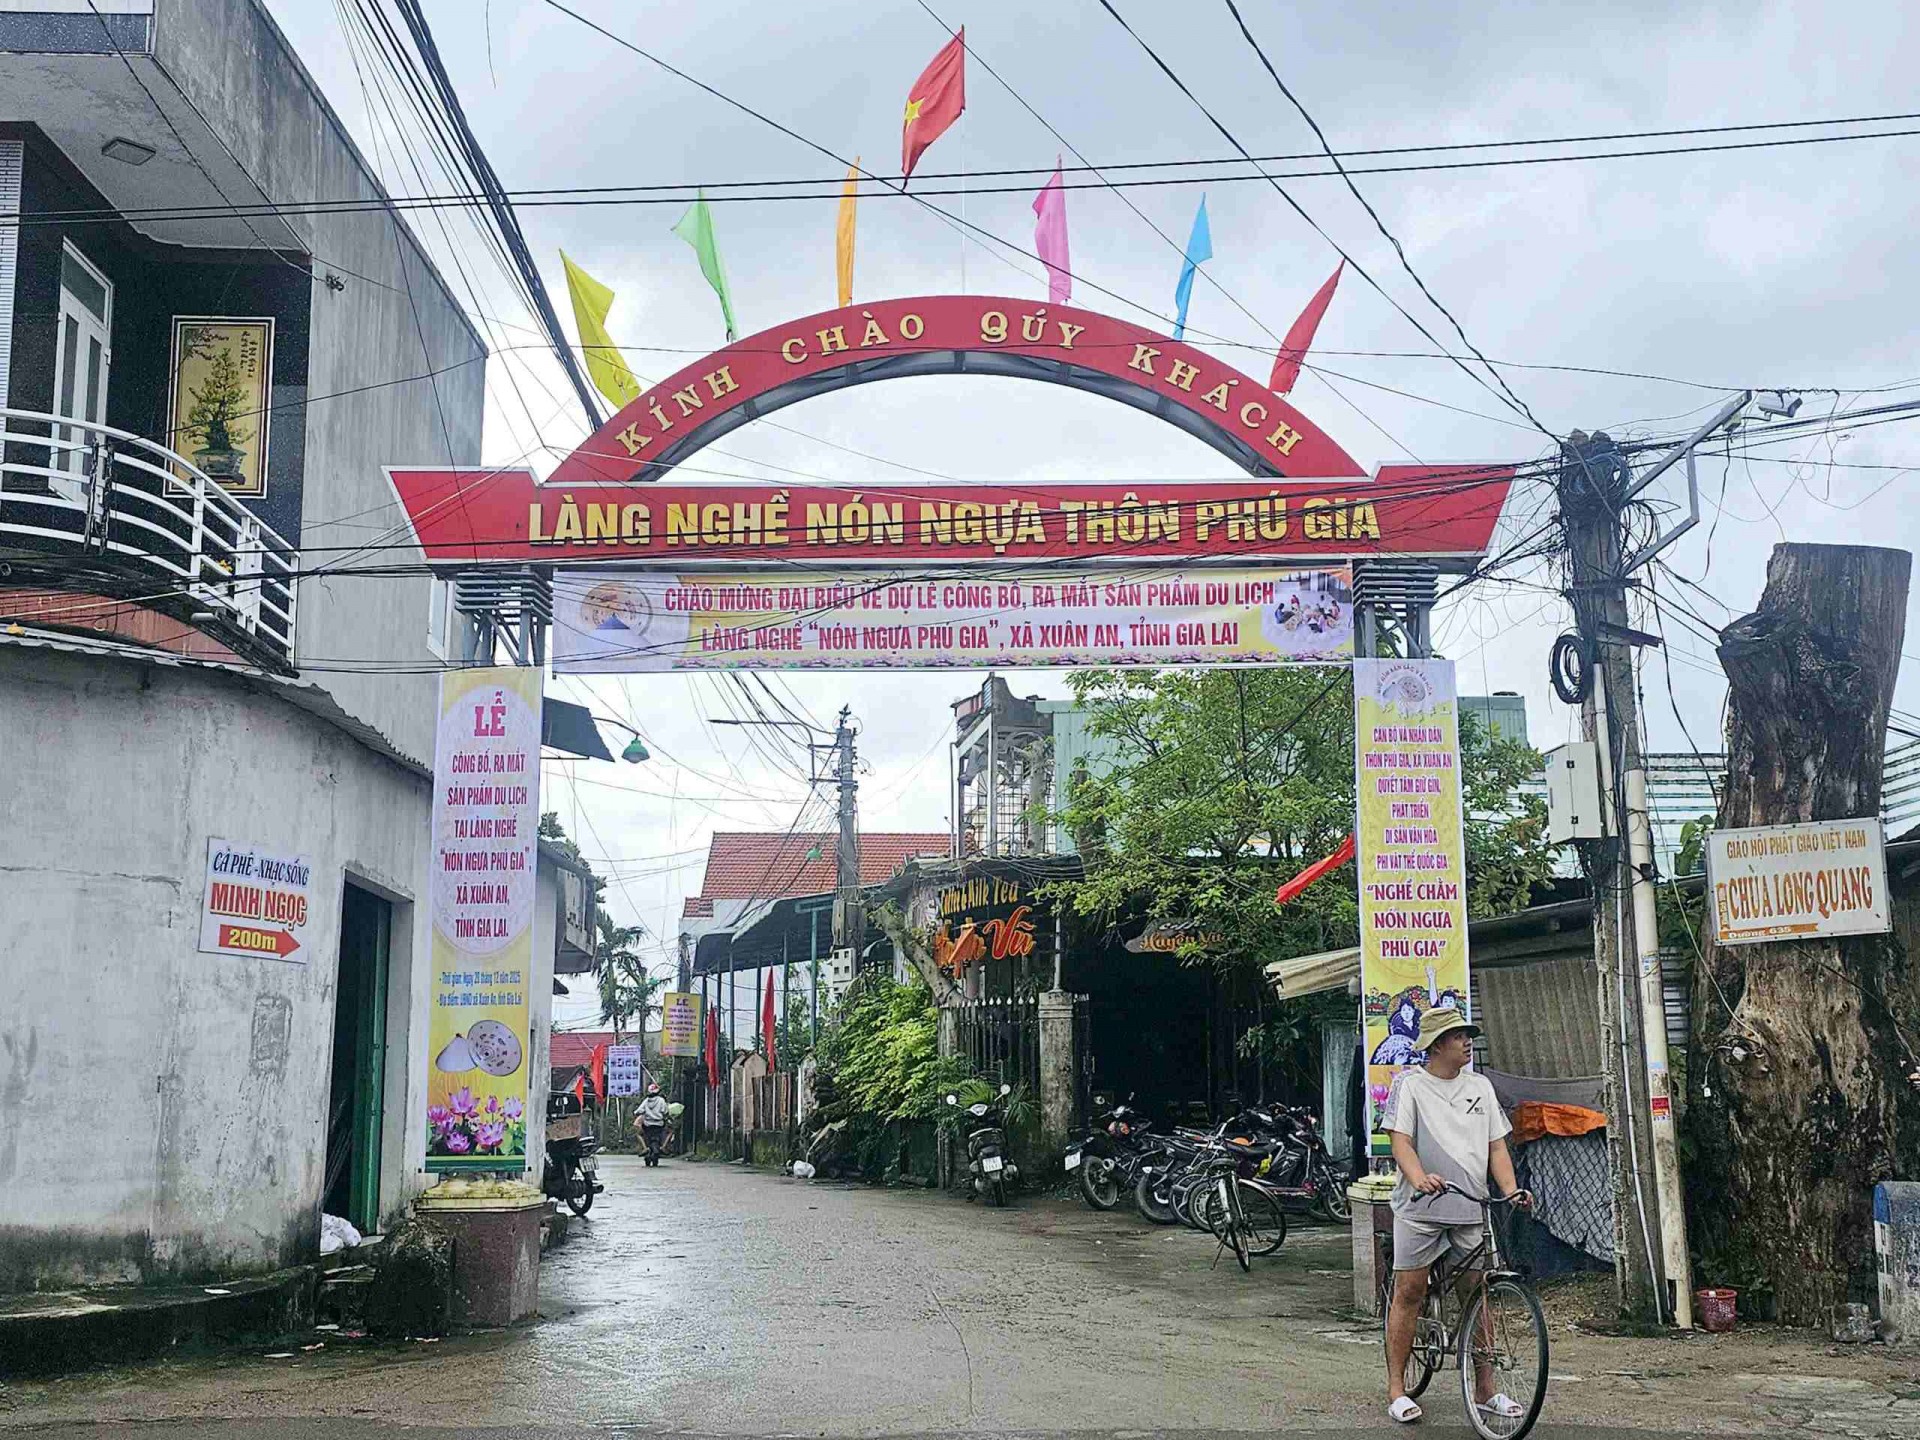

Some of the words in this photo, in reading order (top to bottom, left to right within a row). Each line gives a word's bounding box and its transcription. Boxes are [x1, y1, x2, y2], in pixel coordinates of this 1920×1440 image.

[614, 364, 740, 457] KÍNH
[781, 310, 925, 364] CHÀO
[980, 307, 1085, 350] QÚY
[1127, 343, 1303, 457] KHÁCH
[528, 493, 651, 546] LÀNG
[666, 489, 791, 546] NGHỀ
[805, 493, 904, 545] NÓN
[919, 497, 1047, 554] NGỰA
[1059, 491, 1181, 544] THÔN
[1195, 490, 1289, 542] PHÚ
[1303, 497, 1381, 541] GIA
[665, 583, 714, 611] CHÀO
[719, 582, 773, 611] MỪNG
[778, 586, 809, 615] ĐẠI
[888, 584, 915, 615] DỰ
[943, 581, 992, 609] CÔNG
[998, 578, 1027, 610] BỐ,
[1033, 585, 1055, 608] RA
[1062, 576, 1099, 607] MẮT
[1104, 576, 1141, 606] SẢN
[1147, 574, 1201, 606] PHẨM
[1205, 582, 1229, 605] DU
[1235, 581, 1274, 609] LỊCH
[701, 622, 749, 651] LÀNG
[755, 620, 802, 651] NGHỀ
[863, 625, 912, 655] NGỰA
[917, 621, 954, 649] PHÚ
[1010, 621, 1034, 649] XÃ
[1039, 620, 1088, 648] XUÂN
[1094, 623, 1124, 649] AN,
[1129, 616, 1170, 646] TỈNH
[1176, 622, 1206, 646] GIA
[1211, 622, 1239, 646] LAI
[474, 690, 507, 737] LỄ
[452, 751, 475, 773] CÔNG
[494, 754, 505, 772] RA
[447, 780, 465, 806] SẢN
[494, 787, 506, 805] DU
[508, 786, 527, 809] LỊCH
[454, 819, 468, 842] TẠI
[470, 815, 492, 838] LÀNG
[1727, 835, 1748, 859] GIÁO
[1751, 833, 1767, 860] HỘI
[1770, 830, 1794, 857] PHẬT
[1797, 828, 1819, 853] GIÁO
[1821, 827, 1841, 854] VIỆT
[1844, 829, 1867, 848] NAM
[213, 847, 231, 872] CÀ
[230, 851, 254, 877] PHÊ
[285, 858, 310, 886] SỐNG
[464, 850, 489, 875] NGỰA
[490, 848, 508, 871] PHÚ
[456, 881, 468, 905] XÃ
[469, 881, 494, 905] XUÂN
[993, 876, 1019, 906] Tea
[1729, 864, 1774, 920] CHÙA
[1773, 870, 1815, 916] LONG
[1816, 865, 1873, 920] QUANG
[210, 882, 262, 920] MINH
[264, 889, 308, 932] NGỌC
[1374, 908, 1407, 929] NÓN
[1411, 911, 1453, 932] NGỰA
[228, 928, 277, 951] 200m
[455, 911, 475, 938] TỈNH
[477, 918, 492, 938] GIA
[982, 905, 1037, 960] Vũ
[1381, 936, 1410, 957] PHÚ
